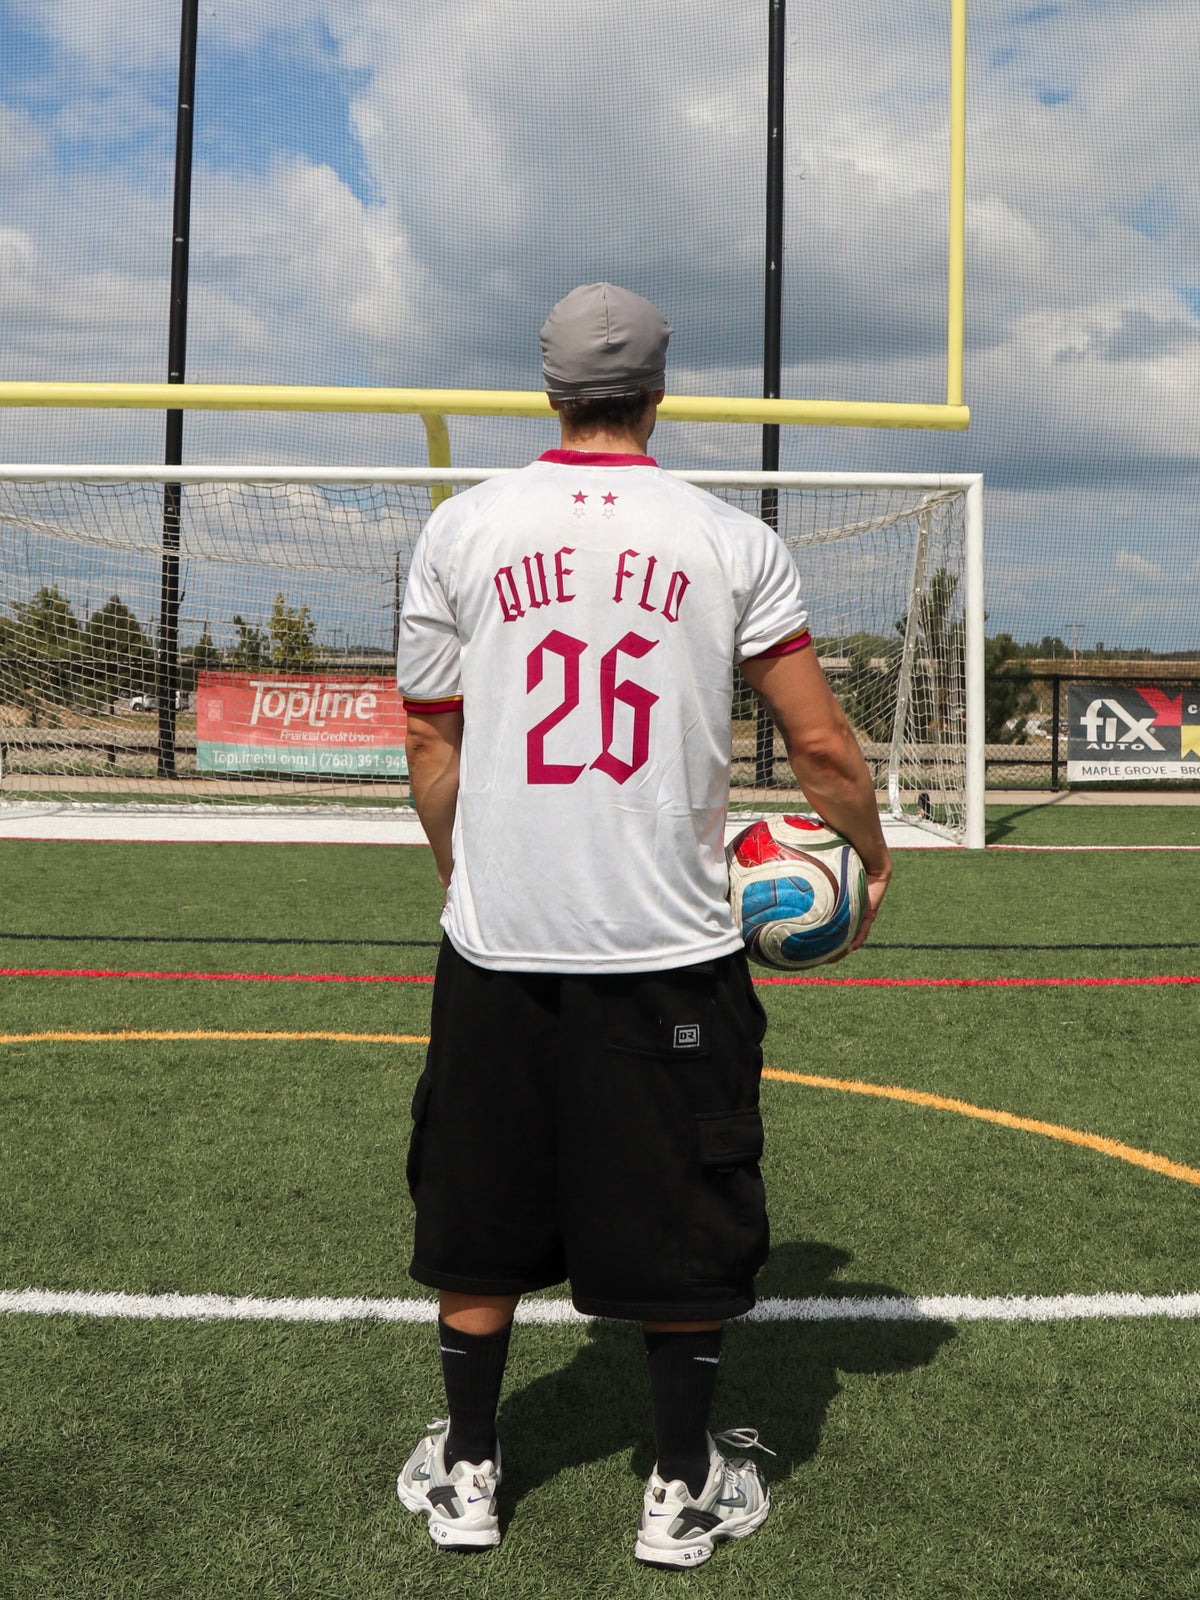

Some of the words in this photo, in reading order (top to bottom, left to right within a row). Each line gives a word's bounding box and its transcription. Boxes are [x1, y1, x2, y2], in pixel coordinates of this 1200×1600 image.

[494, 546, 576, 623] QUE
[611, 548, 691, 623] FLO
[249, 681, 379, 727] TopLine
[526, 629, 660, 785] 26
[1080, 699, 1166, 751] fix
[280, 729, 320, 741] Financial
[320, 731, 348, 742] Credit
[349, 732, 375, 742] Union
[319, 753, 353, 769] (763)
[1081, 766, 1121, 776] MAPLE
[1124, 766, 1167, 775] GROVE
[1180, 766, 1200, 775] BR
